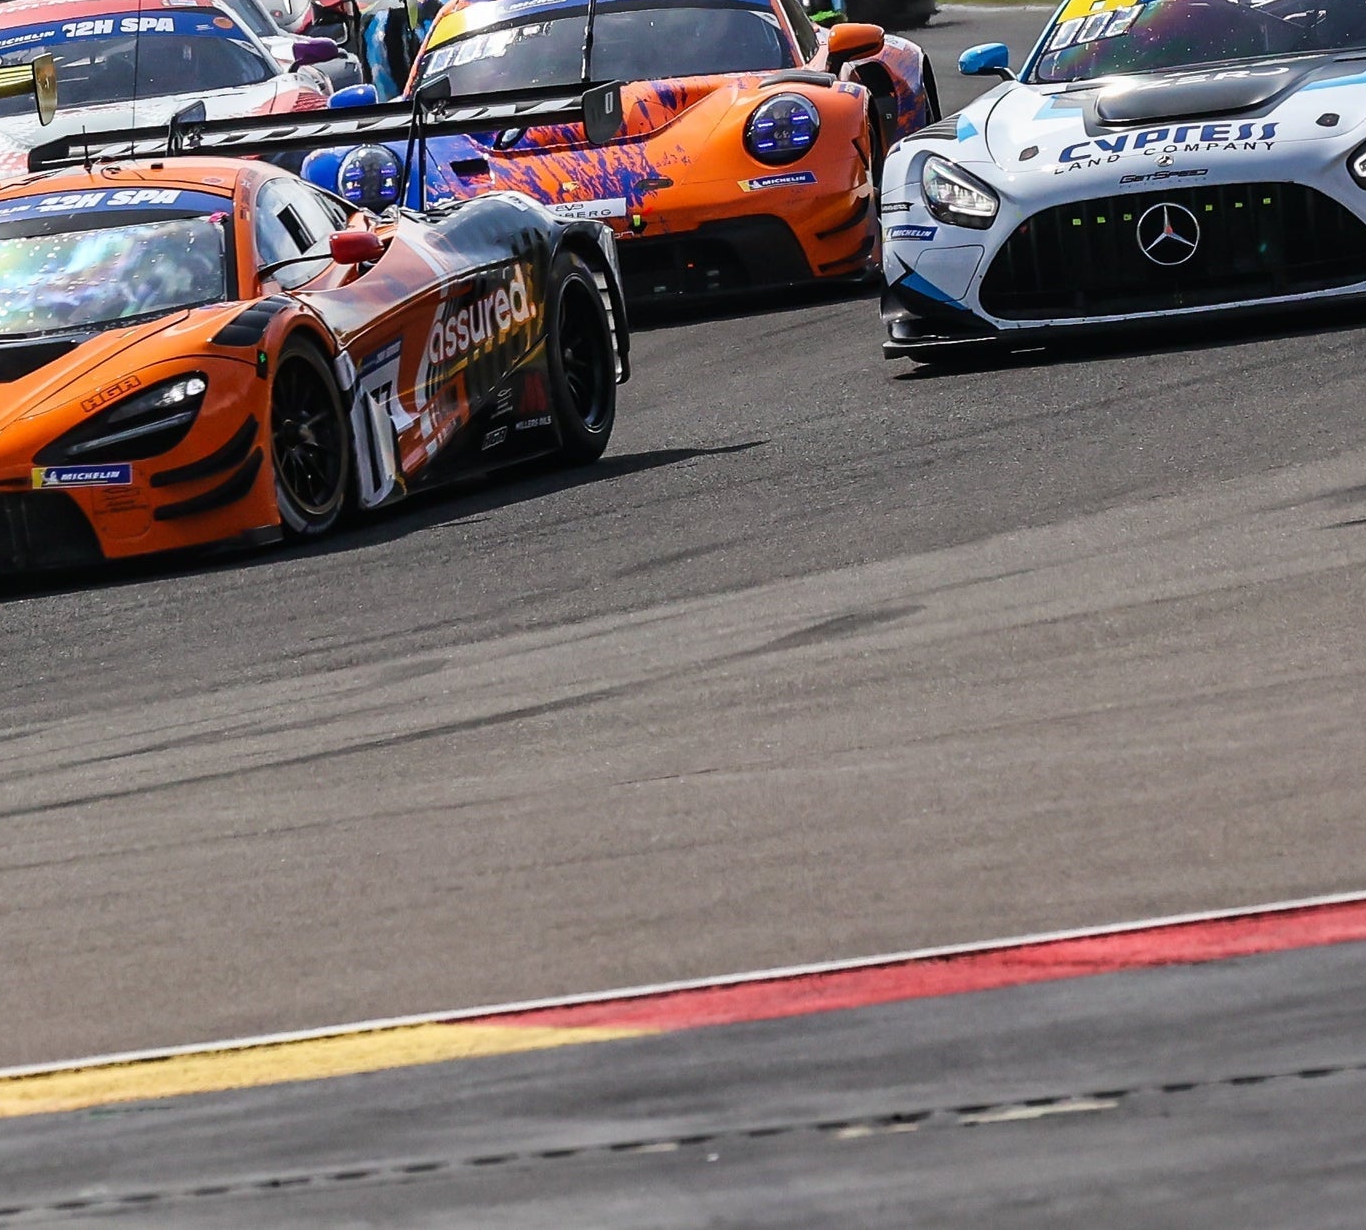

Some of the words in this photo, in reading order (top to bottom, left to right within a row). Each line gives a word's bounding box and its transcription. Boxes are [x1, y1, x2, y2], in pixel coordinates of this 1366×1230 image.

[61, 20, 113, 37] 12H
[119, 17, 175, 32] SPA
[427, 33, 507, 76] 00
[1058, 122, 1281, 163] CYPRESS
[1054, 153, 1121, 175] LAND
[1143, 141, 1276, 156] COMPANY
[760, 173, 807, 187] MICHELIN
[35, 190, 106, 213] 12H
[106, 188, 182, 207] SPA
[891, 229, 933, 237] MICHELIN
[429, 263, 538, 364] assured.
[60, 470, 121, 482] MICHELIN
